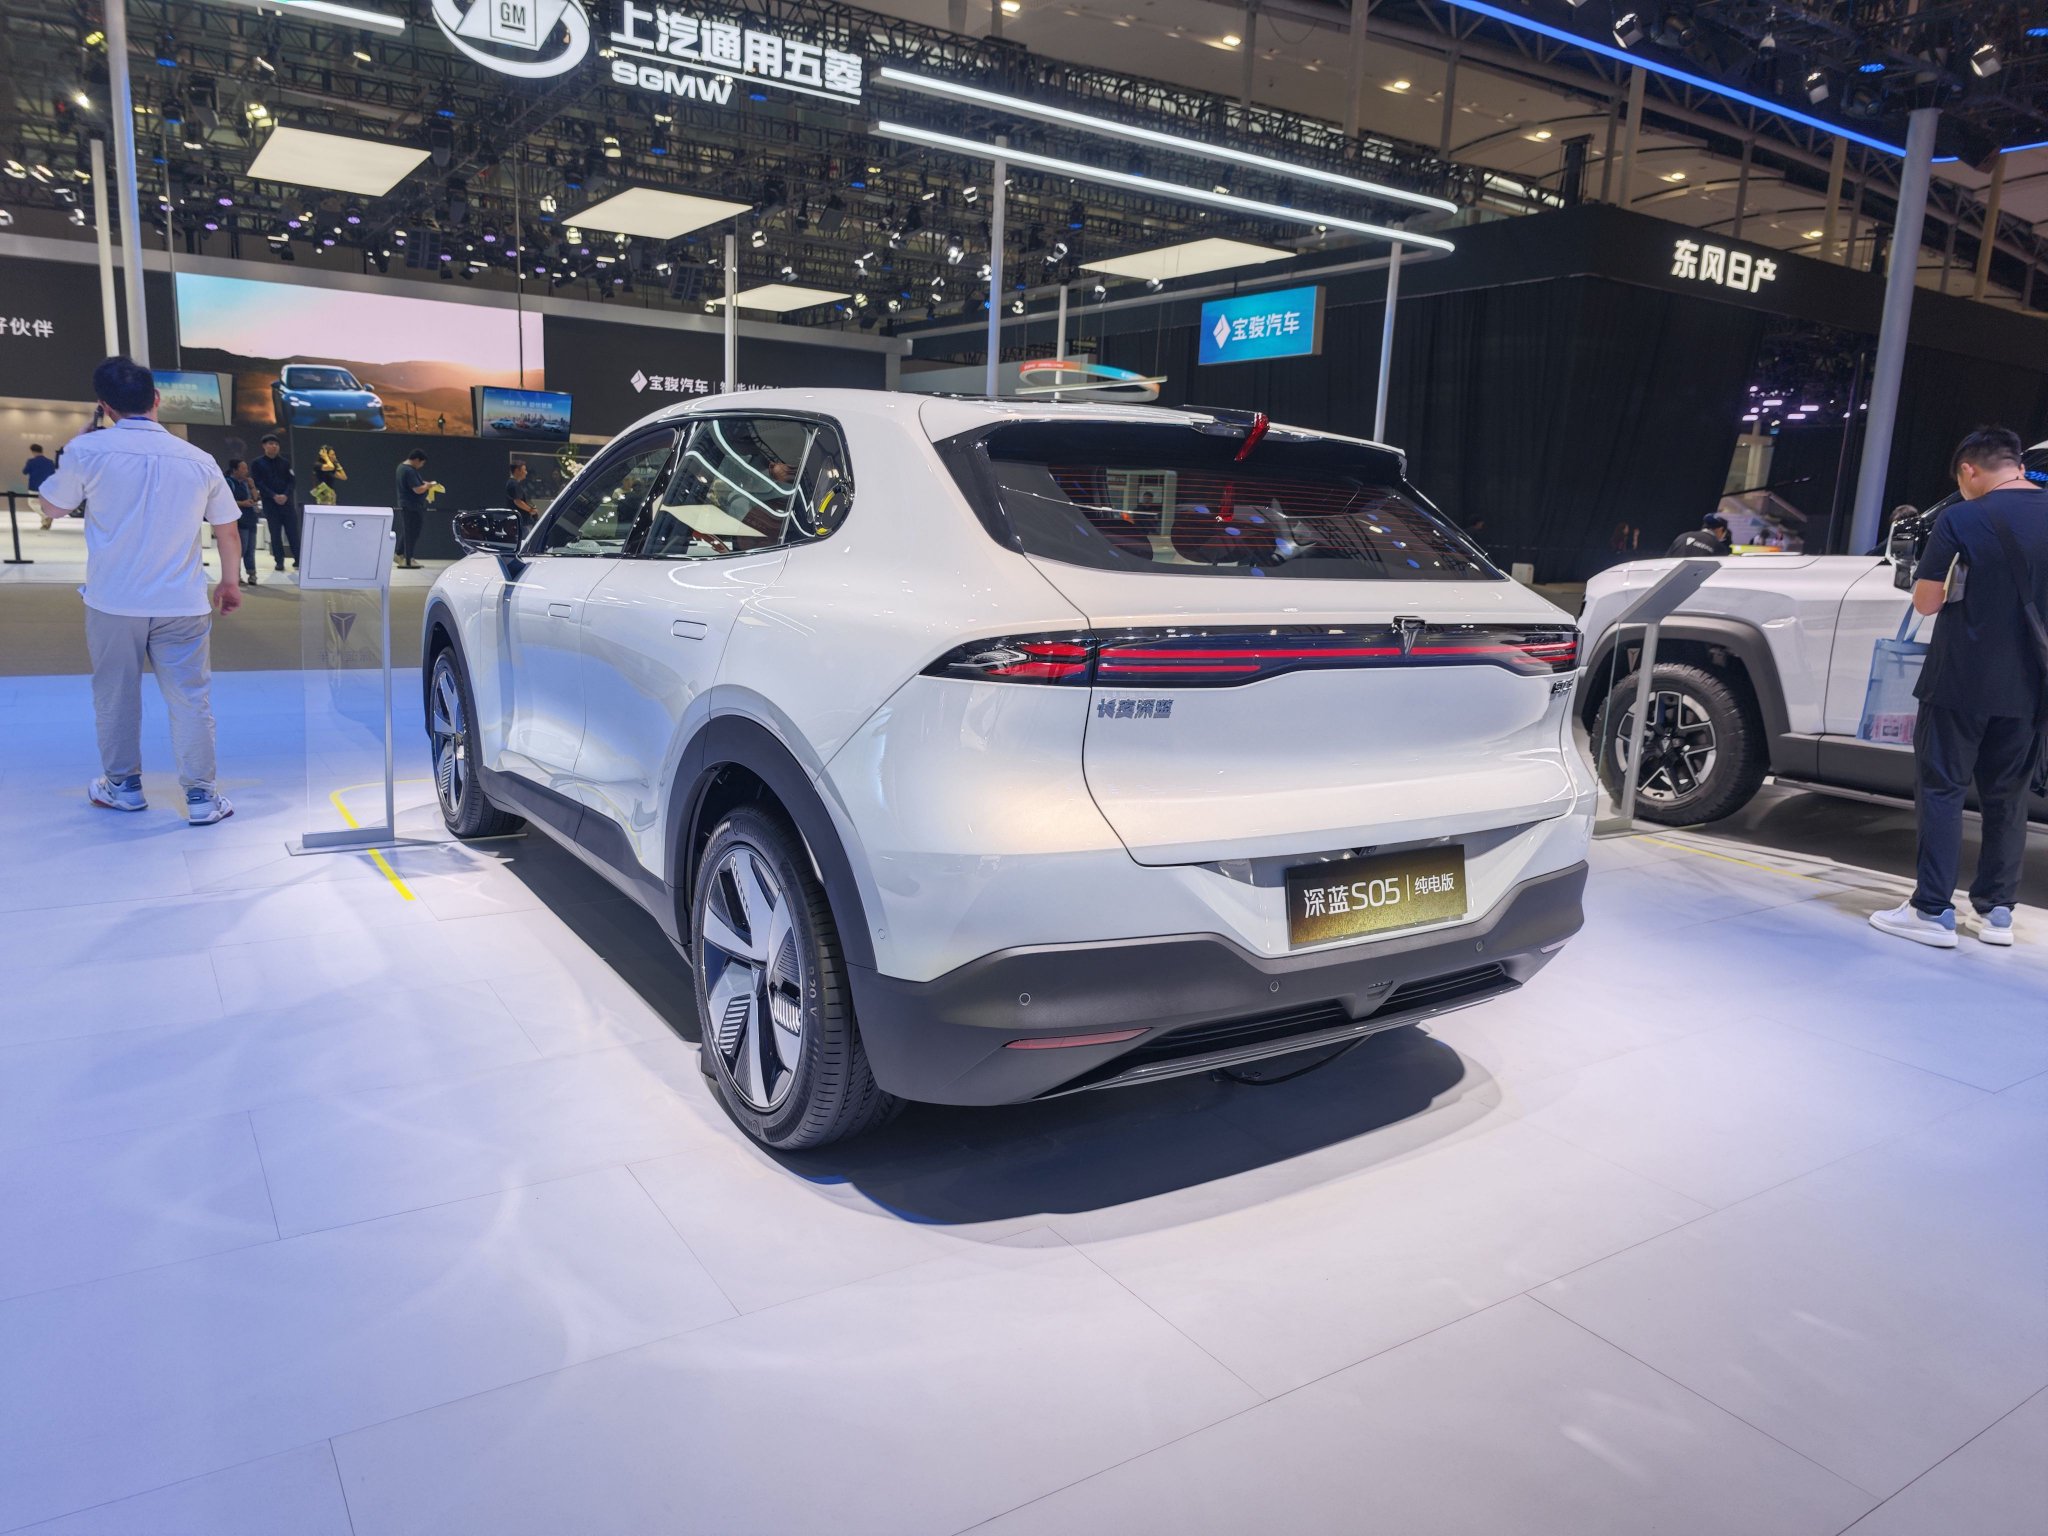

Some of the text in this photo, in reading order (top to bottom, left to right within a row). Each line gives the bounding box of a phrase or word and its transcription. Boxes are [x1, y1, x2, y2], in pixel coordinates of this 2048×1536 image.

[500, 2, 526, 26] GM
[611, 0, 862, 96] 上汽通用五菱
[611, 61, 733, 105] SGMW
[1671, 239, 1777, 293] 东风日产
[1232, 311, 1300, 341] 宝骏汽车
[649, 375, 709, 394] 宝骏汽车
[1303, 872, 1455, 919] 深蓝S05 纯电版
